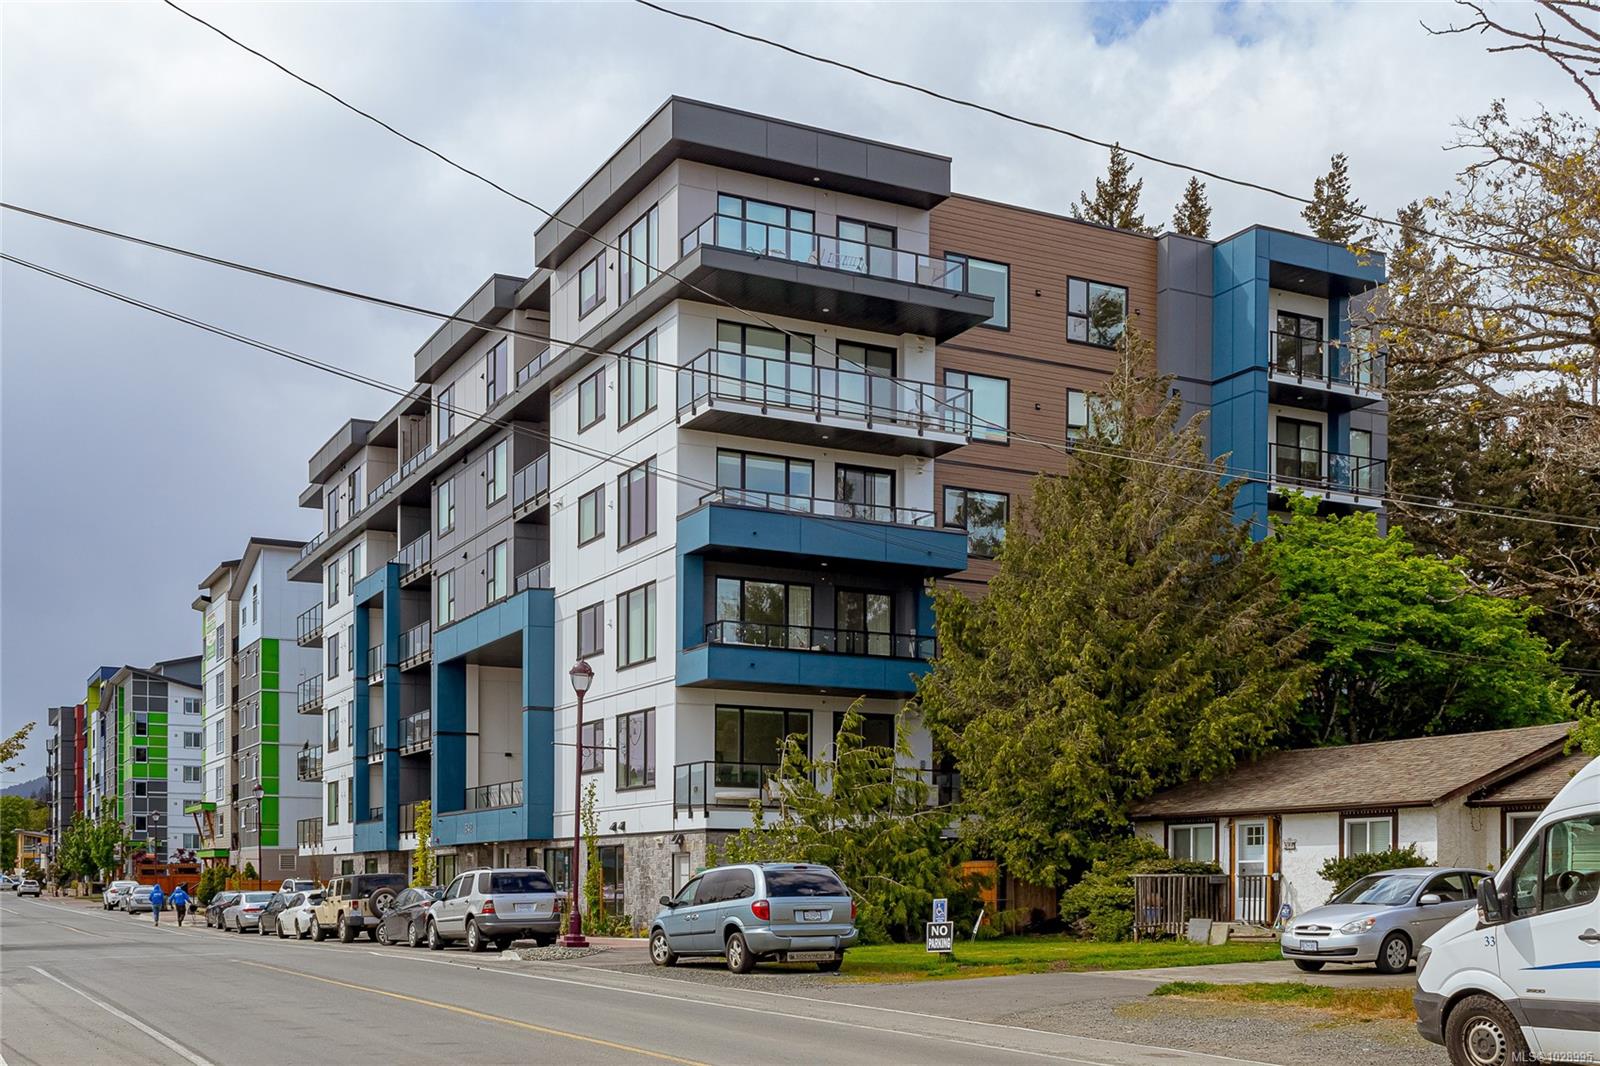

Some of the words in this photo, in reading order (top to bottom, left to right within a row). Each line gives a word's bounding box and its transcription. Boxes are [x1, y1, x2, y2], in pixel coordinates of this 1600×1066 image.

[931, 926, 948, 936] NO
[928, 937, 951, 949] PARKING
[1484, 936, 1496, 947] 33
